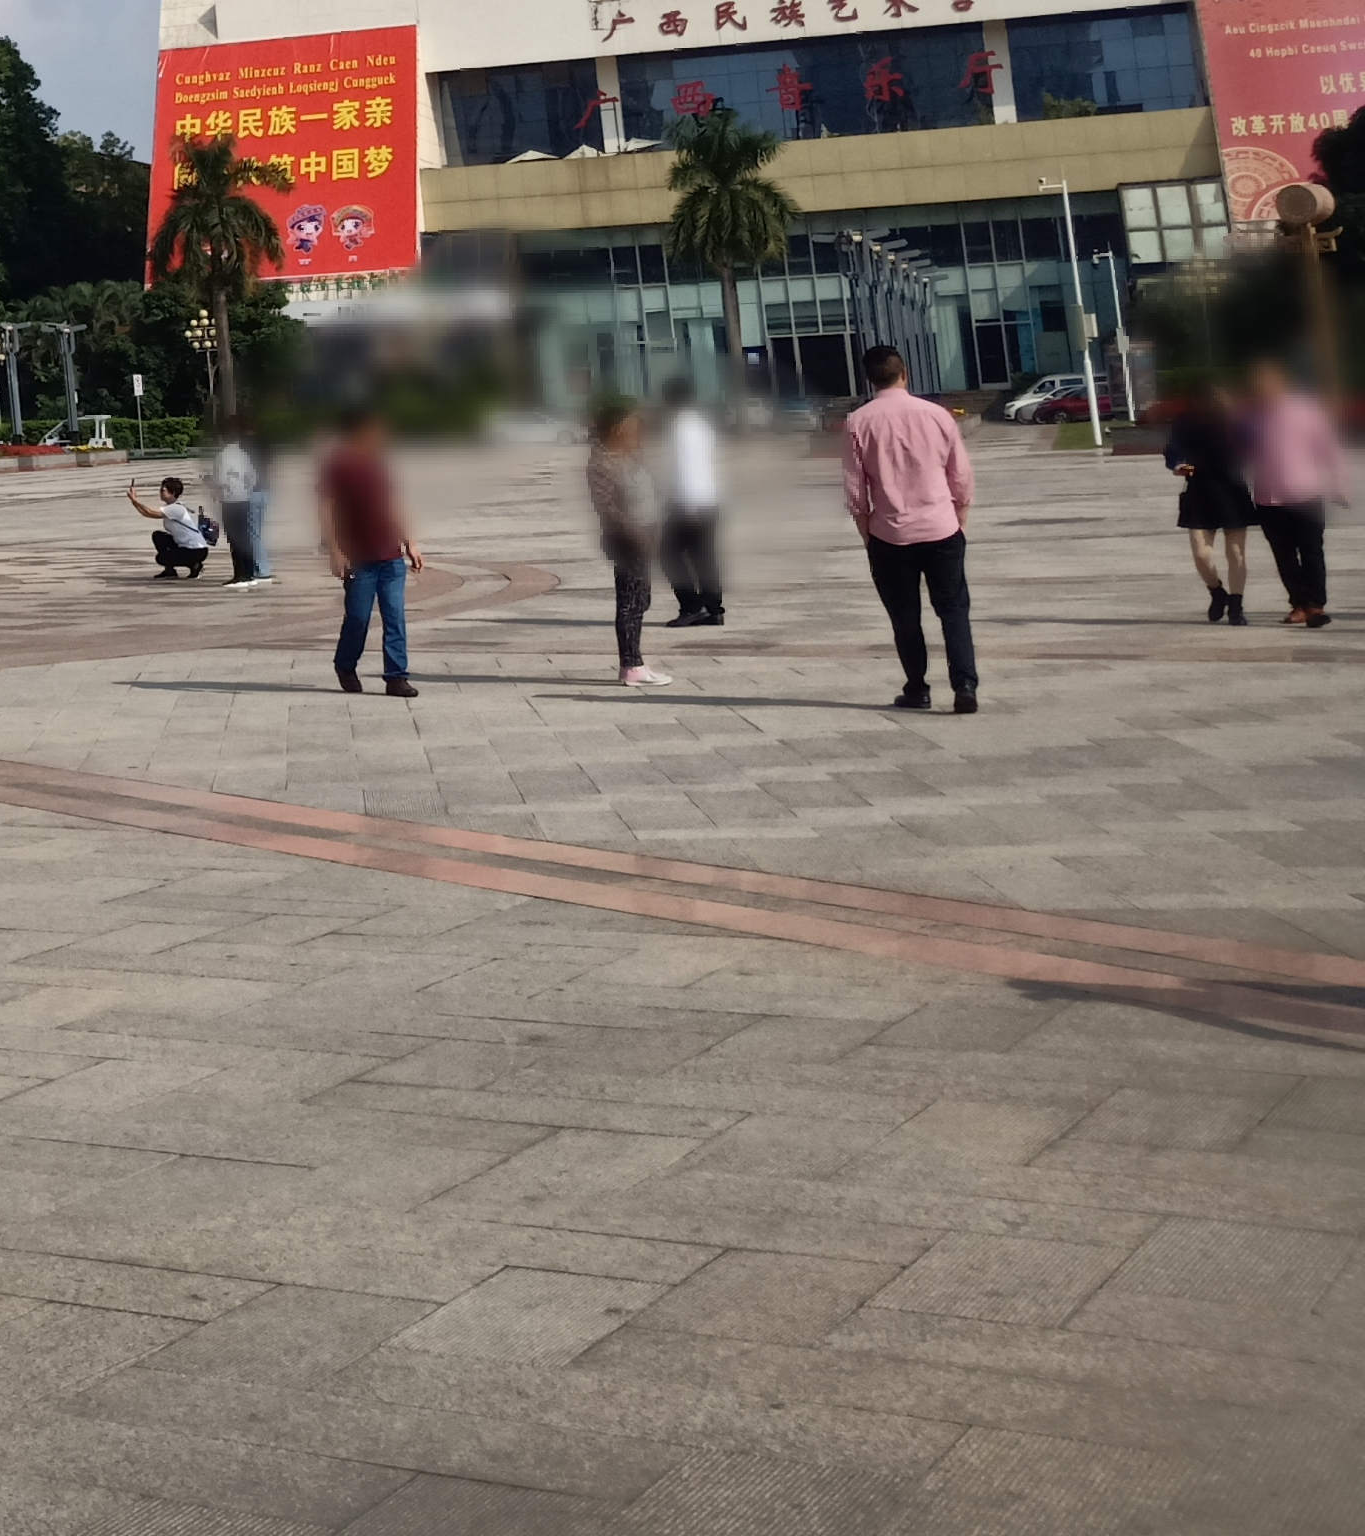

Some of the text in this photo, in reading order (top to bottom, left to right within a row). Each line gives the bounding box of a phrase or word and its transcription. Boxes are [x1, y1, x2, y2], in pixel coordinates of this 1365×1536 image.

[175, 54, 397, 87] Cunghvaz Minzcuz Ranz Caen Ndeu
[175, 72, 397, 105] Doengzsim Saedyienh Loqsiengj Cungguek
[574, 50, 1004, 130] 广西音乐厅
[175, 96, 394, 142] 中华民族一家亲
